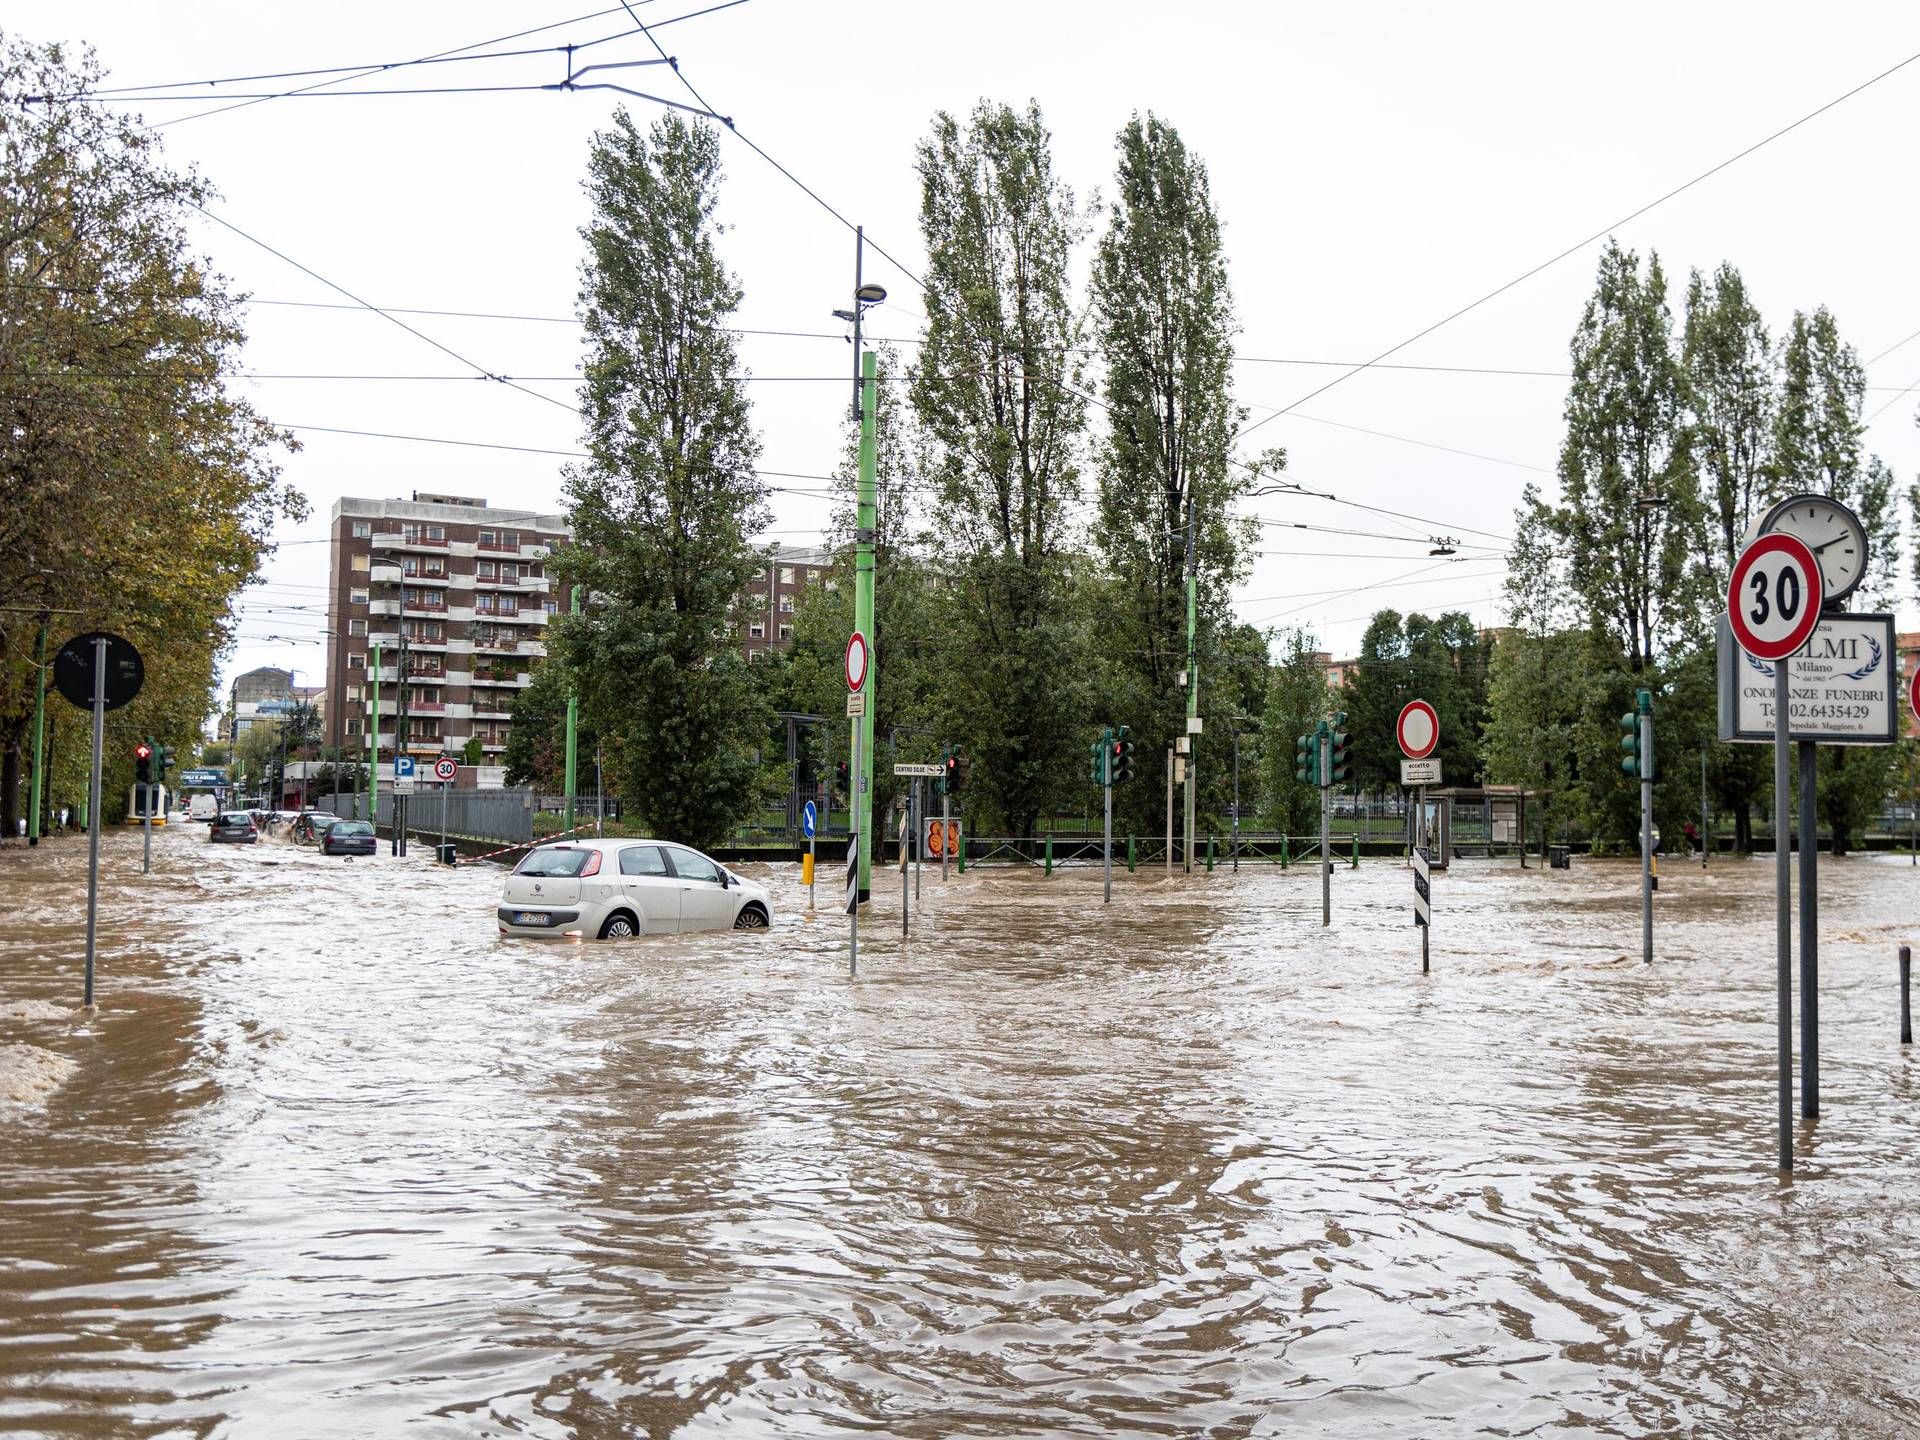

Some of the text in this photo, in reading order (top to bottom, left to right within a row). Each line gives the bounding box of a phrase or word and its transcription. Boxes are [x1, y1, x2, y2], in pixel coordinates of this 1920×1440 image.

[1750, 566, 1800, 625] 30
[1788, 638, 1859, 660] LMI
[1796, 661, 1833, 673] Milano
[1743, 688, 1884, 702] ONONZE FUNEBRI
[1760, 703, 1869, 719] Te 02.6435429
[397, 758, 411, 775] P
[439, 764, 453, 774] 30
